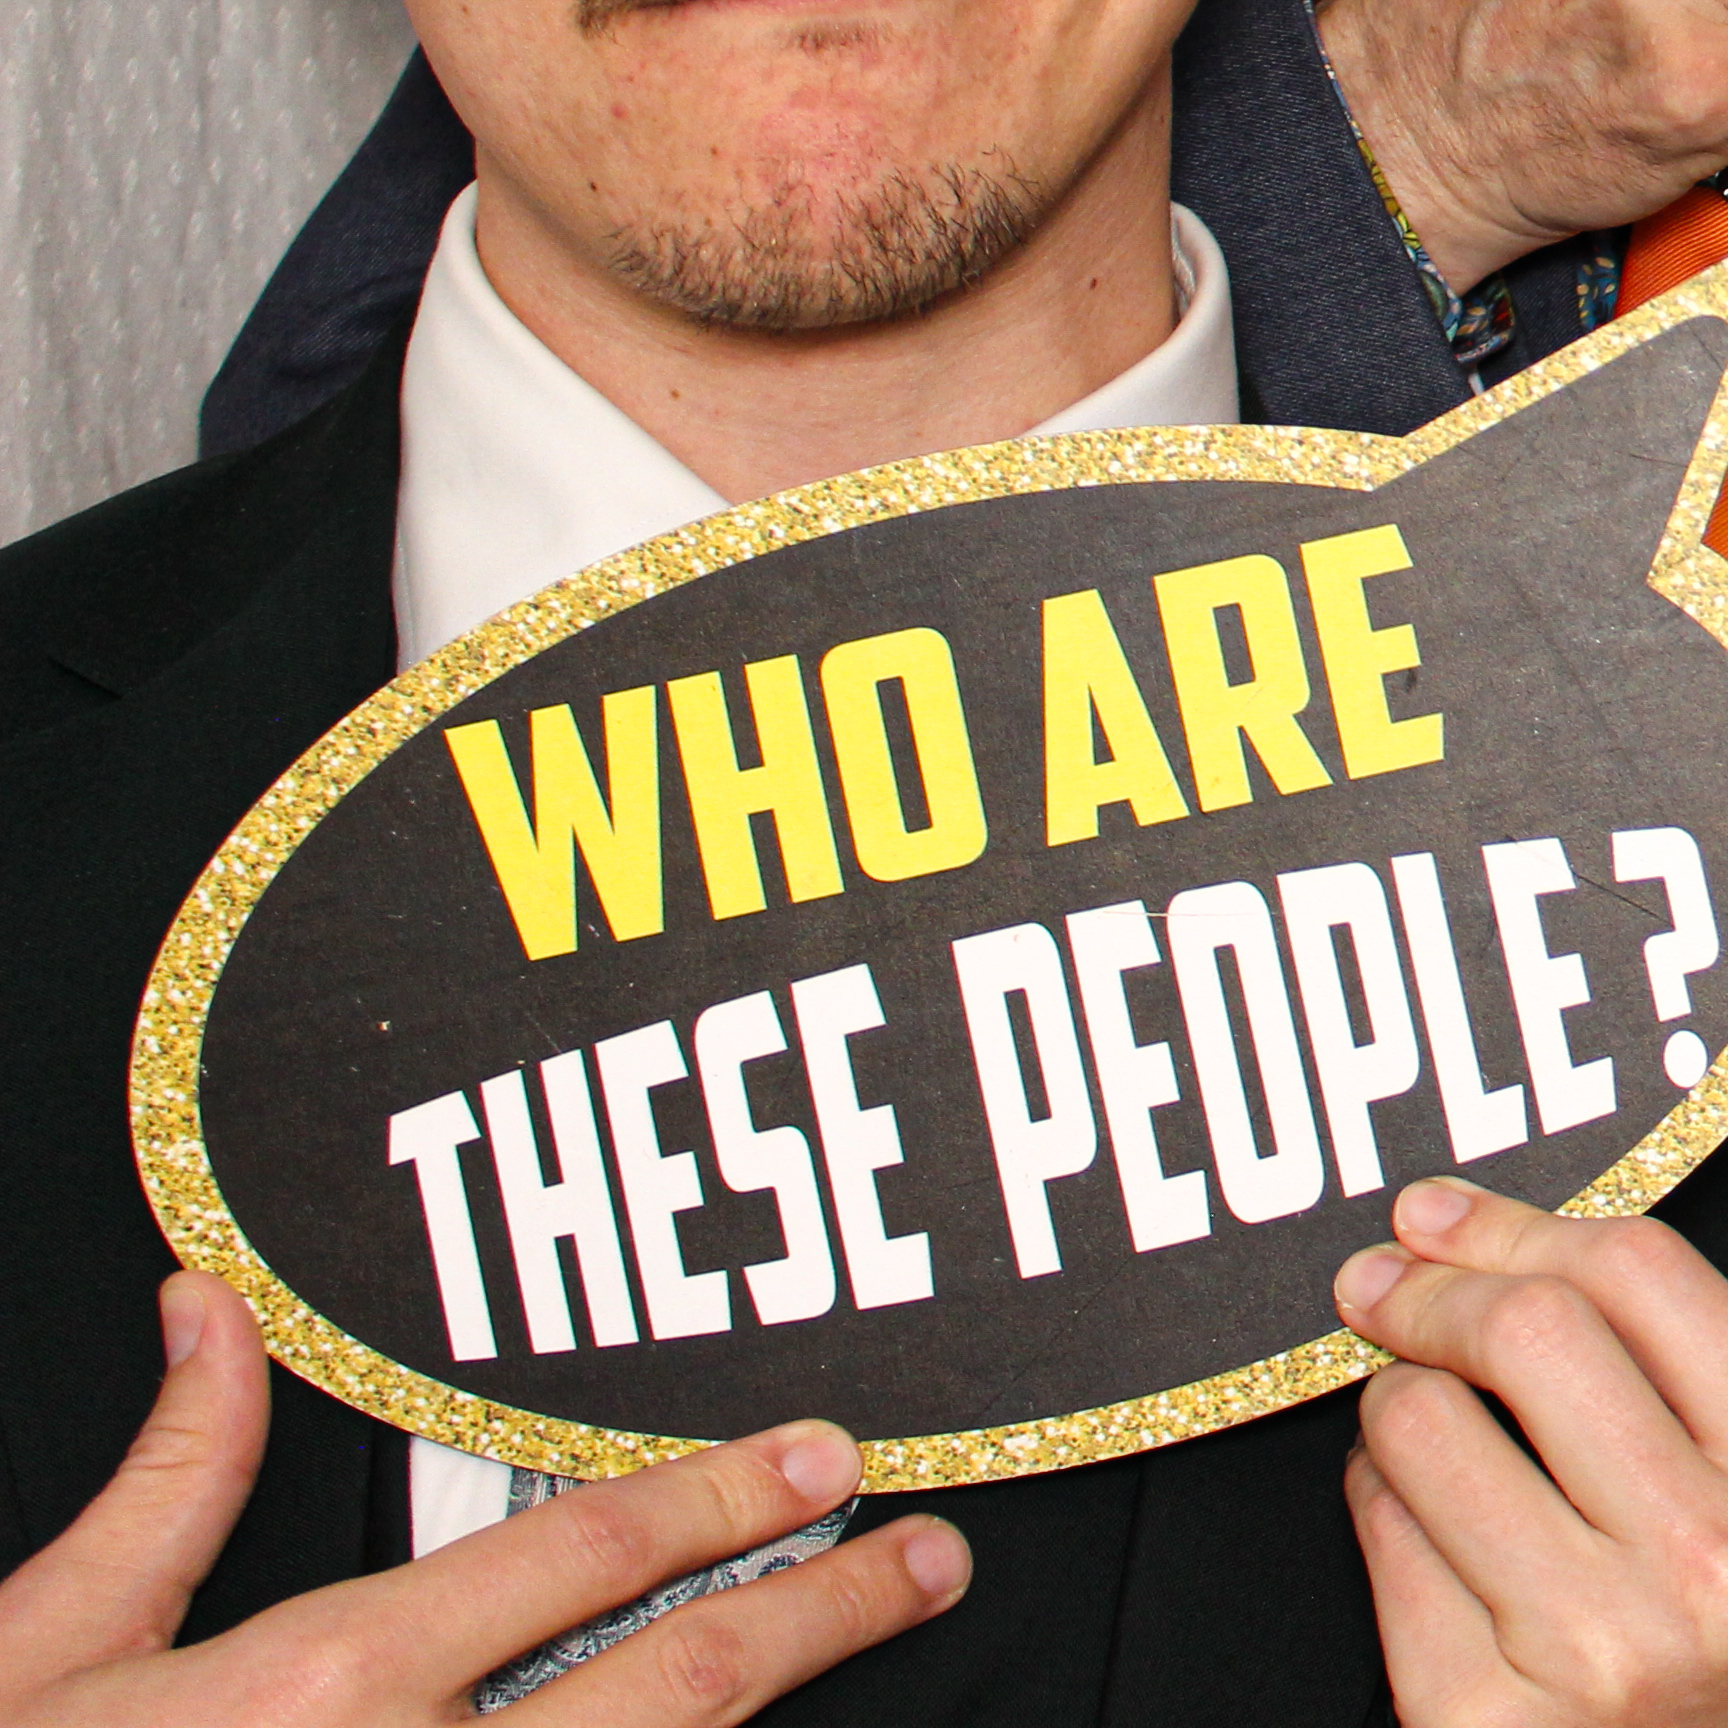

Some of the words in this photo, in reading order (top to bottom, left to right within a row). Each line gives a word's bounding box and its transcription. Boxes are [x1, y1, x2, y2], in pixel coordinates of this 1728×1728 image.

[445, 628, 986, 962] WHO
[1043, 524, 1443, 847] ARE
[389, 962, 935, 1362] THESE
[953, 826, 1721, 1279] PEOPLE?
